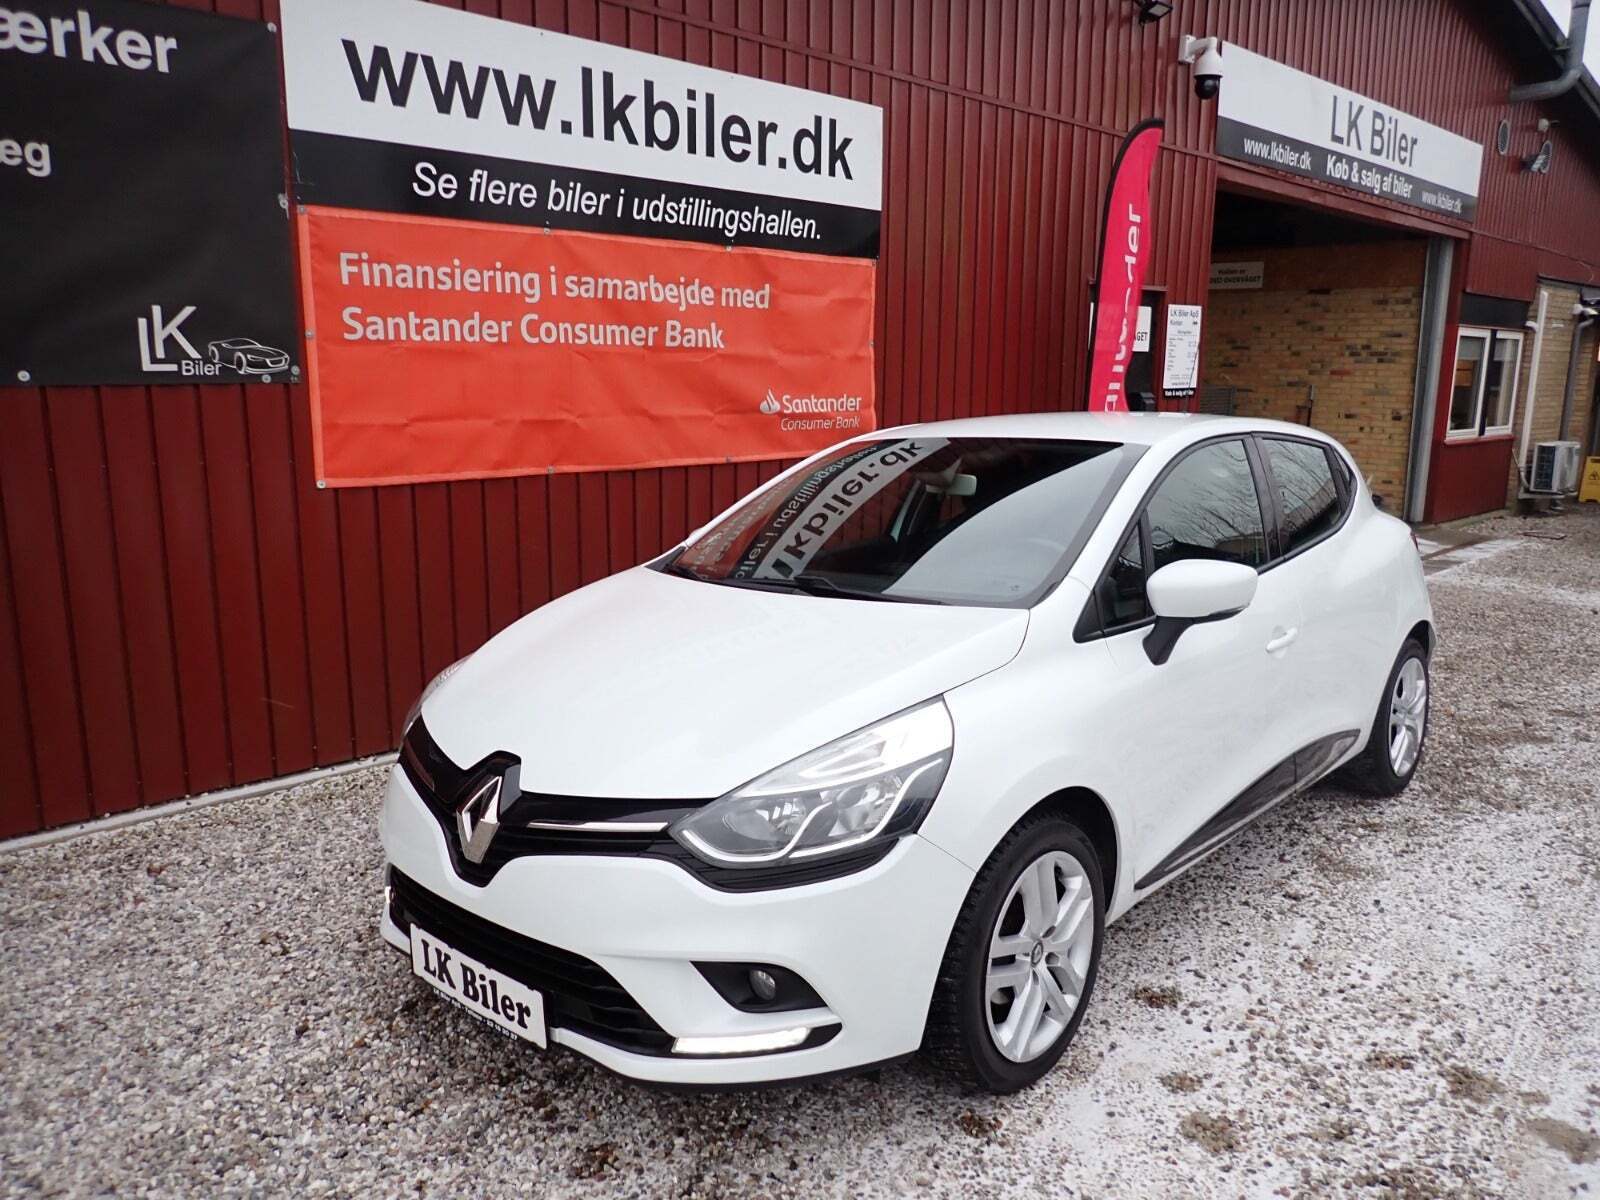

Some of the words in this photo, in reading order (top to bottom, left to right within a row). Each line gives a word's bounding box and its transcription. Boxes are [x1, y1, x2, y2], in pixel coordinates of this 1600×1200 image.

[340, 38, 855, 180] www.lkbiler.dk
[1330, 95, 1364, 151] LK
[1370, 110, 1418, 168] Biler
[1243, 137, 1312, 171] www.lkbiler.dk
[1326, 154, 1349, 181] Køb
[1351, 162, 1359, 183] &
[1361, 168, 1381, 194] salg
[1382, 172, 1392, 193] af
[1392, 174, 1413, 199] biler
[412, 161, 458, 199] Se
[468, 168, 538, 208] flere
[547, 179, 611, 217] biler
[616, 188, 624, 218] i
[631, 194, 821, 241] udstillingshallen.
[1421, 190, 1463, 214] www.lkbiler.dk
[339, 251, 541, 303] Finansiering
[550, 265, 558, 296] i
[564, 273, 715, 313] samarbejde
[720, 284, 770, 310] med
[138, 305, 202, 371] LK
[342, 306, 512, 343] Santander
[519, 313, 659, 348] Consumer
[665, 319, 725, 350] Bank
[181, 360, 222, 376] Biler
[781, 417, 834, 431] Consumer
[836, 416, 860, 429] Bank
[782, 394, 862, 414] Santander
[421, 938, 456, 990] LK
[460, 961, 531, 1030] Biler
